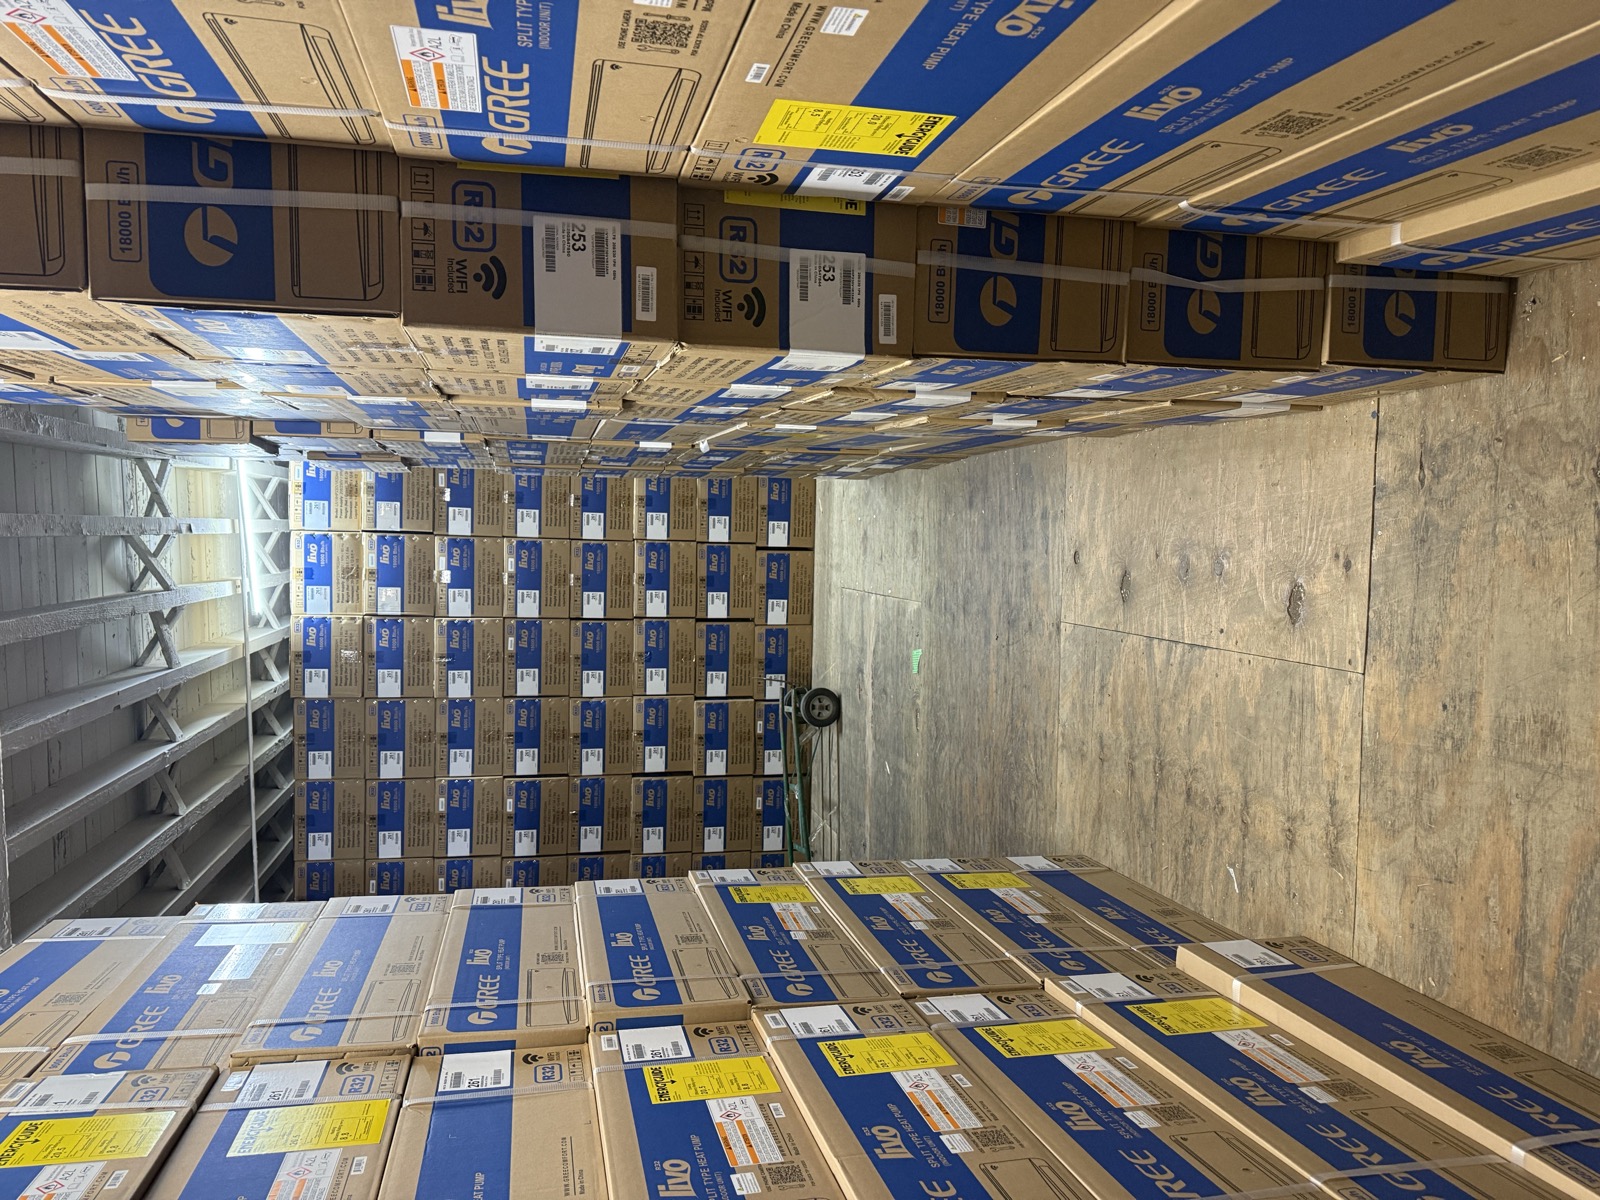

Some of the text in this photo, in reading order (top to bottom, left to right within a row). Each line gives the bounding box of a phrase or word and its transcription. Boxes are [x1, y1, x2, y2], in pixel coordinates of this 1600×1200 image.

[789, 2, 799, 17] Made
[517, 24, 532, 47] SPLIT
[538, 20, 552, 50] (INDOOR
[776, 23, 789, 39] China
[942, 22, 972, 47] HEAT
[1027, 26, 1045, 39] R32
[427, 37, 441, 50] A2L
[774, 5, 827, 88] WWW.GREECOMFORT.COM
[80, 9, 197, 98] GREE
[922, 47, 950, 70] PUMP
[482, 56, 530, 133] GREE
[1159, 57, 1295, 134] SPLIT TYPE HEAT PUMP
[1123, 87, 1202, 122] livo
[1451, 132, 1492, 149] TYPE
[1492, 116, 1534, 134] HEAT
[1533, 99, 1578, 119] PUMP
[894, 115, 942, 156] ENERGYGUIDE
[1386, 123, 1474, 153] livo
[746, 151, 768, 169] R2
[1041, 138, 1145, 190] GREE
[1262, 167, 1388, 213] GREE
[464, 190, 484, 243] R32
[118, 212, 131, 254] 18000
[571, 223, 586, 252] 253
[729, 225, 747, 275] R32
[447, 258, 455, 294] Included
[455, 258, 468, 294] WIFI
[822, 255, 835, 282] 253
[722, 290, 732, 322] WIFI
[935, 281, 945, 317] 18000
[1146, 291, 1156, 325] 18000
[1346, 299, 1356, 327] 18000
[308, 544, 318, 564] livo
[380, 544, 390, 565] livo
[451, 548, 460, 567] livo
[519, 550, 528, 569] livo
[585, 552, 594, 570] livo
[648, 551, 657, 569] livo
[769, 561, 778, 579] livo
[306, 627, 316, 647] livo
[379, 627, 389, 648] livo
[518, 630, 528, 649] livo
[585, 631, 593, 649] livo
[648, 630, 657, 648] livo
[451, 709, 461, 728] livo
[584, 710, 593, 728] livo
[708, 712, 716, 730] livo
[310, 790, 320, 810] livo
[450, 789, 460, 808] livo
[517, 790, 527, 809] livo
[646, 789, 654, 806] livo
[765, 789, 774, 806] livo
[380, 872, 390, 890] livo
[866, 916, 895, 931] livo
[981, 909, 1014, 924] livo
[611, 932, 634, 947] livo
[747, 925, 770, 941] livo
[897, 939, 942, 970] GREE
[1020, 931, 1074, 959] GREE
[466, 948, 492, 966] livo
[769, 949, 807, 981] GREE
[312, 960, 343, 977] livo
[629, 954, 657, 986] GREE
[144, 974, 183, 994] livo
[475, 974, 500, 1009] GREE
[304, 988, 342, 1024] GREE
[1020, 1005, 1042, 1017] R32
[116, 1006, 170, 1049] GREE
[718, 1026, 728, 1035] WIFI
[878, 1015, 898, 1028] R32
[718, 1039, 733, 1052] R32
[983, 1027, 1020, 1057] ENERGYGUIDE
[547, 1052, 555, 1062] WIFI
[651, 1050, 662, 1059] 261
[825, 1042, 857, 1075] ENERGYGUIDE
[1390, 1041, 1454, 1069] livo
[362, 1061, 372, 1072] WIFI
[542, 1065, 555, 1081] R32
[158, 1074, 172, 1085] WIFI
[348, 1076, 366, 1093] R32
[468, 1078, 481, 1088] 261
[652, 1066, 672, 1103] ENERGYGUIDE
[913, 1072, 924, 1082] A2L
[267, 1090, 283, 1101] 261
[1062, 1082, 1079, 1094] PUMP
[1230, 1077, 1287, 1106] livo
[1267, 1083, 1290, 1098] TYPE
[730, 1101, 739, 1111] A2L
[1075, 1093, 1095, 1107] HEAT
[1288, 1099, 1316, 1115] SPLIT
[1055, 1101, 1106, 1131] livo
[1093, 1107, 1112, 1122] TYPE
[237, 1110, 271, 1154] ENERGYGUIDE
[862, 1127, 871, 1137] R32
[886, 1103, 941, 1168] SPLIT TYPE HEAT PUMP
[1109, 1122, 1134, 1139] SPLIT
[870, 1125, 916, 1160] livo
[304, 1155, 318, 1167] A2L
[561, 1136, 570, 1197] WWW.GREECOMFORT.COM
[653, 1160, 661, 1171] R32
[690, 1134, 714, 1188] TYPE HEAT PUMP
[1307, 1122, 1428, 1192] GREE
[64, 1168, 77, 1181] A2L
[473, 1172, 485, 1187] PUMP
[657, 1159, 699, 1198] livo
